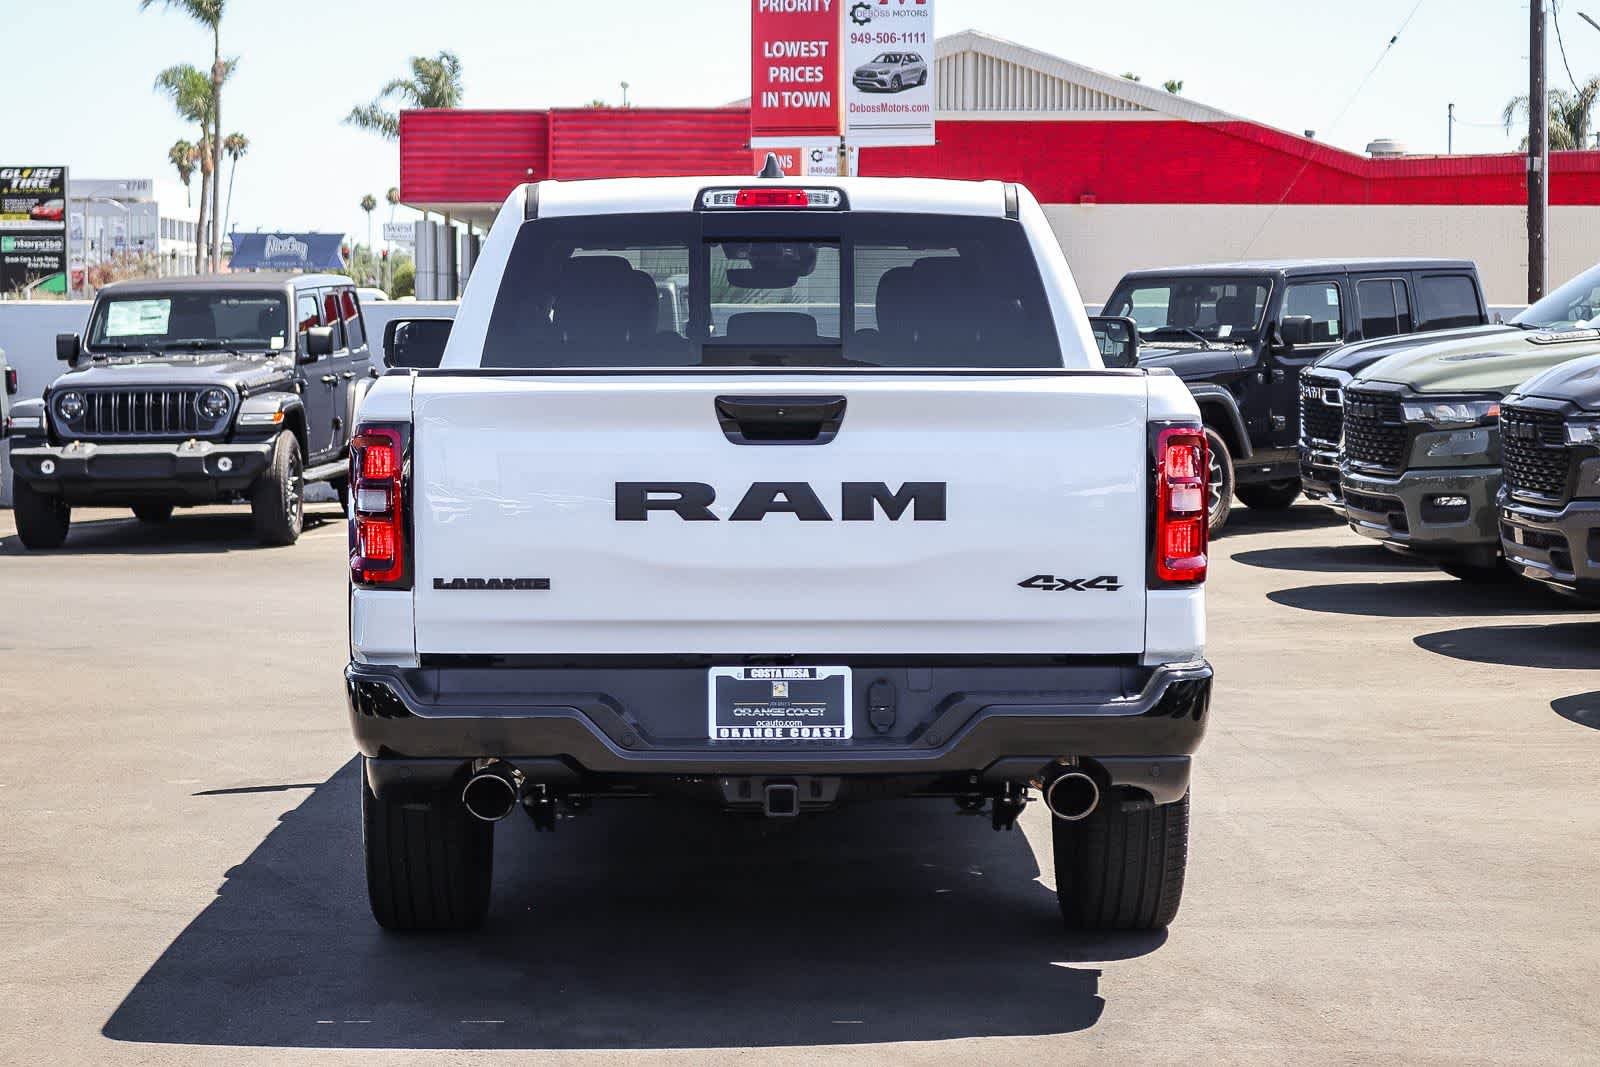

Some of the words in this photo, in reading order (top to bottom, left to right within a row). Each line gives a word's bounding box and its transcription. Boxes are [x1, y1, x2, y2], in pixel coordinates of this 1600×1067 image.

[759, 0, 832, 13] PRIORITY
[892, 9, 928, 17] MOTORS
[850, 32, 926, 44] 949-506-1111
[764, 41, 829, 58] LOWEST
[769, 66, 824, 83] PRICES
[761, 91, 779, 108] IN
[782, 91, 831, 108] TOWN
[850, 102, 930, 113] DebossMotors.com
[11, 179, 51, 189] TIRE
[2, 236, 62, 251] nterprise
[615, 481, 946, 521] RAM
[432, 577, 550, 590] LARAMIE
[1017, 575, 1124, 591] 4x4
[750, 669, 782, 678] COSTA
[783, 669, 810, 678] MESA
[733, 707, 785, 716] ORANGE
[786, 707, 826, 716] COAST
[720, 728, 783, 737] ORANGE
[790, 728, 842, 737] COAST
